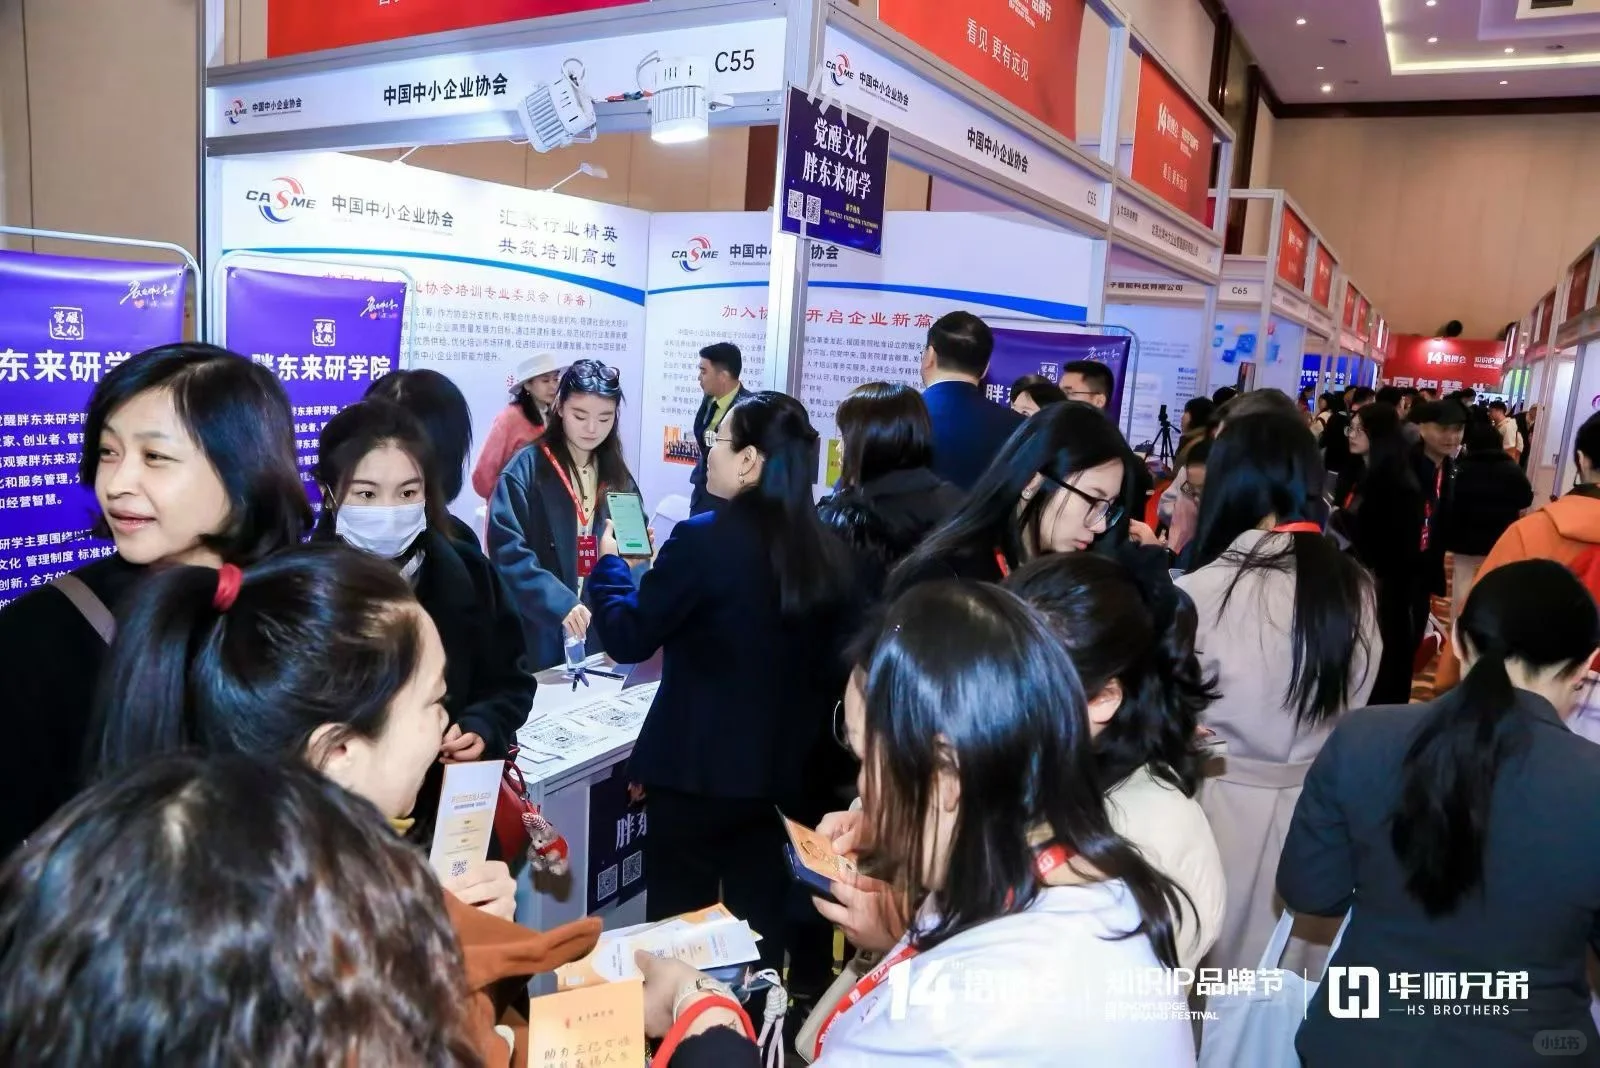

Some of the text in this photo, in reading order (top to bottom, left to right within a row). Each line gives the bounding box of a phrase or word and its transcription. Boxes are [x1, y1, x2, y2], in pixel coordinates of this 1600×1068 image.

[966, 18, 1029, 81] 看见 更有远见
[715, 49, 754, 72] C55
[384, 73, 508, 107] 中国中小企业协会
[859, 71, 909, 106] 中国中小企业协会
[252, 98, 302, 113] 中国中小企业协会
[813, 117, 868, 165] 觉醒文化
[967, 126, 1029, 174] 中国中小企业协会
[802, 150, 872, 200] 胖东来研学
[246, 190, 316, 210] CASME
[1087, 188, 1098, 207] C55
[332, 195, 454, 228] 中国中小企业协会
[499, 237, 617, 268] 共筑培训高地
[671, 246, 719, 263] CASME
[1231, 286, 1248, 295] C65
[805, 309, 941, 328] 开启企业新篇
[53, 325, 81, 337] 文化
[1427, 352, 1442, 364] 14
[291, 405, 348, 416] 东来研学院，
[0, 433, 85, 447] 家、创业者、管
[0, 558, 21, 570] 文化
[26, 551, 74, 567] 管理制度
[0, 570, 72, 591] 创新，全方
